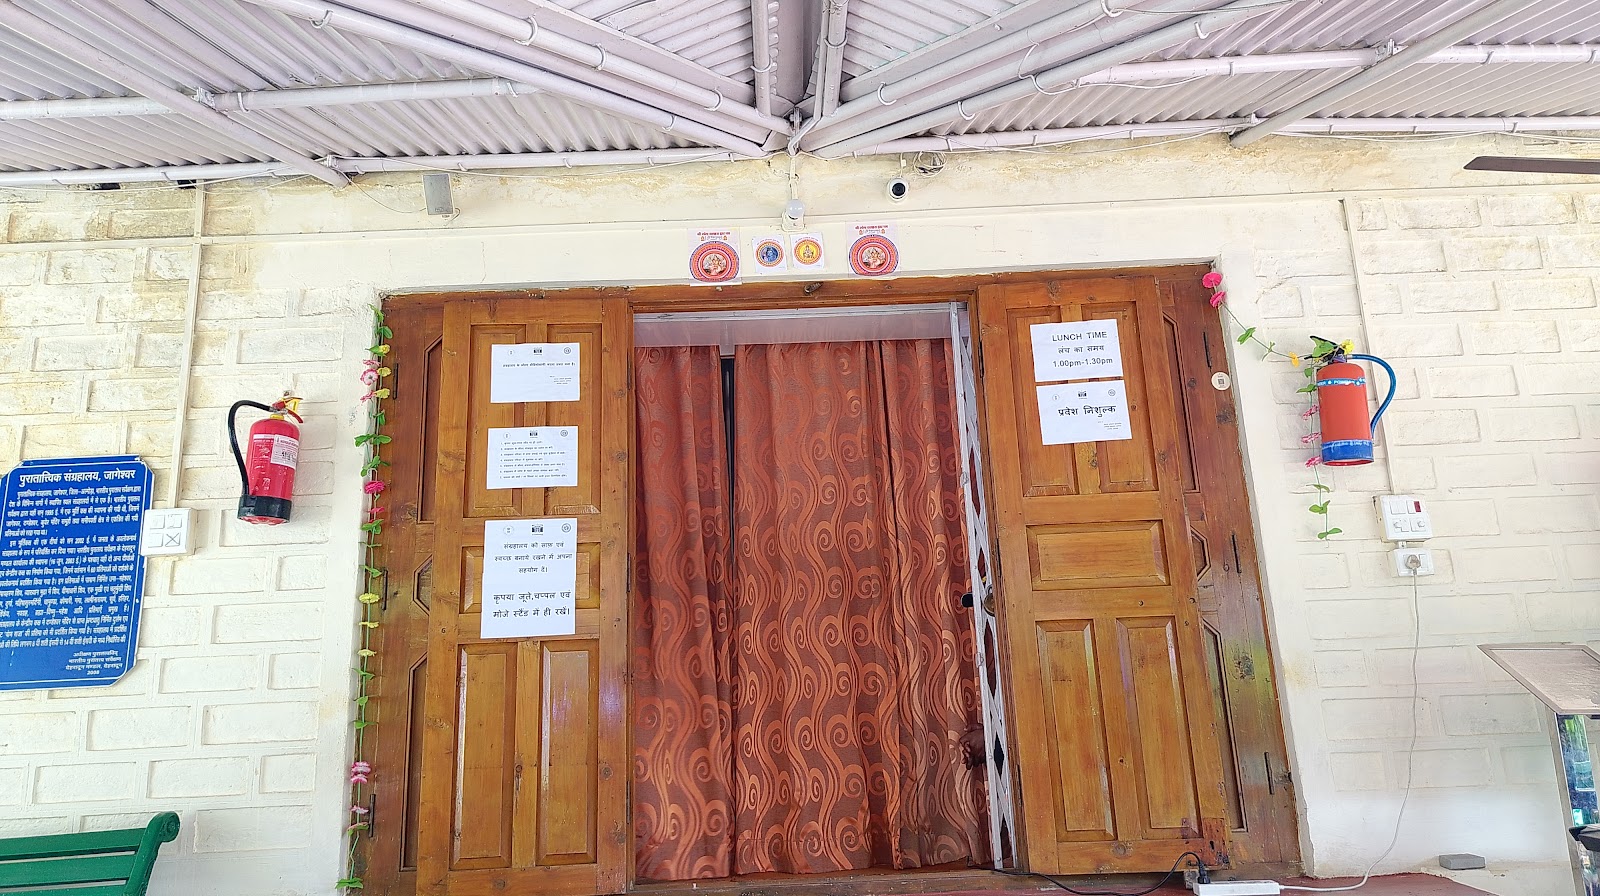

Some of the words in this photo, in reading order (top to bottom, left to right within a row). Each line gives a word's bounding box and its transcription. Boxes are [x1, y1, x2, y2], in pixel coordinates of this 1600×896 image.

[1052, 333, 1083, 342] LUNCH
[1086, 331, 1108, 339] TIME
[1058, 345, 1070, 354] लंच
[1087, 344, 1104, 352] समय
[1052, 358, 1113, 368] 1.00pm-1.30pm
[1057, 406, 1079, 417] प्रवेश
[1083, 404, 1117, 417] निशुल्क
[64, 469, 101, 482] संग्रहालय,
[104, 468, 136, 480] जागेश्वर
[503, 541, 528, 549] संग्रहालय
[518, 566, 538, 574] सहयोग
[493, 593, 515, 605] कृपया
[560, 590, 572, 599] एवं
[493, 609, 510, 619] मोजे
[513, 607, 529, 617] स्टैंड
[543, 607, 551, 616] ही
